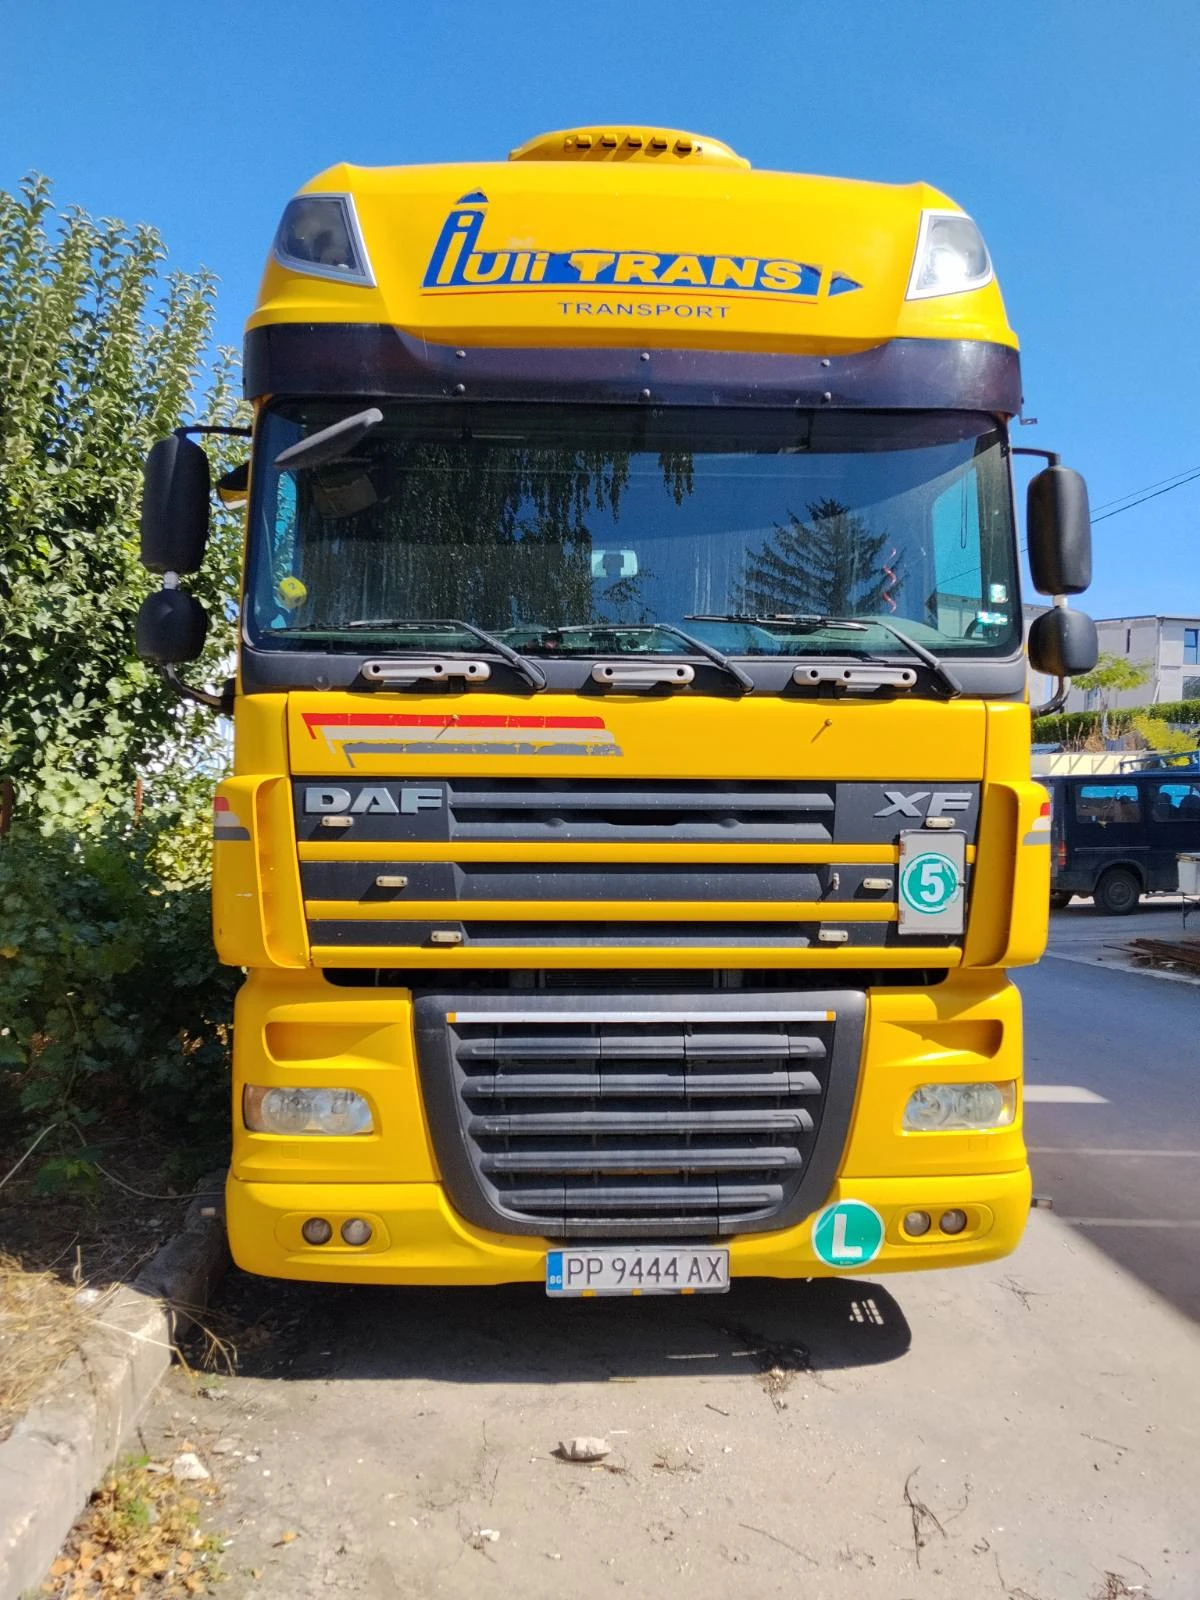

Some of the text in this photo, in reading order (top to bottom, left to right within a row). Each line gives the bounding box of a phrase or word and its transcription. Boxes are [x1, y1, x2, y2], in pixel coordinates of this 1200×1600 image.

[568, 251, 802, 290] TRANS
[557, 302, 731, 319] TRANSPORT
[305, 787, 443, 814] DAF
[873, 791, 973, 818] XF
[920, 863, 945, 903] 5
[832, 1213, 863, 1258] L
[550, 1275, 562, 1284] BG
[567, 1256, 722, 1285] PP 9444 AX
